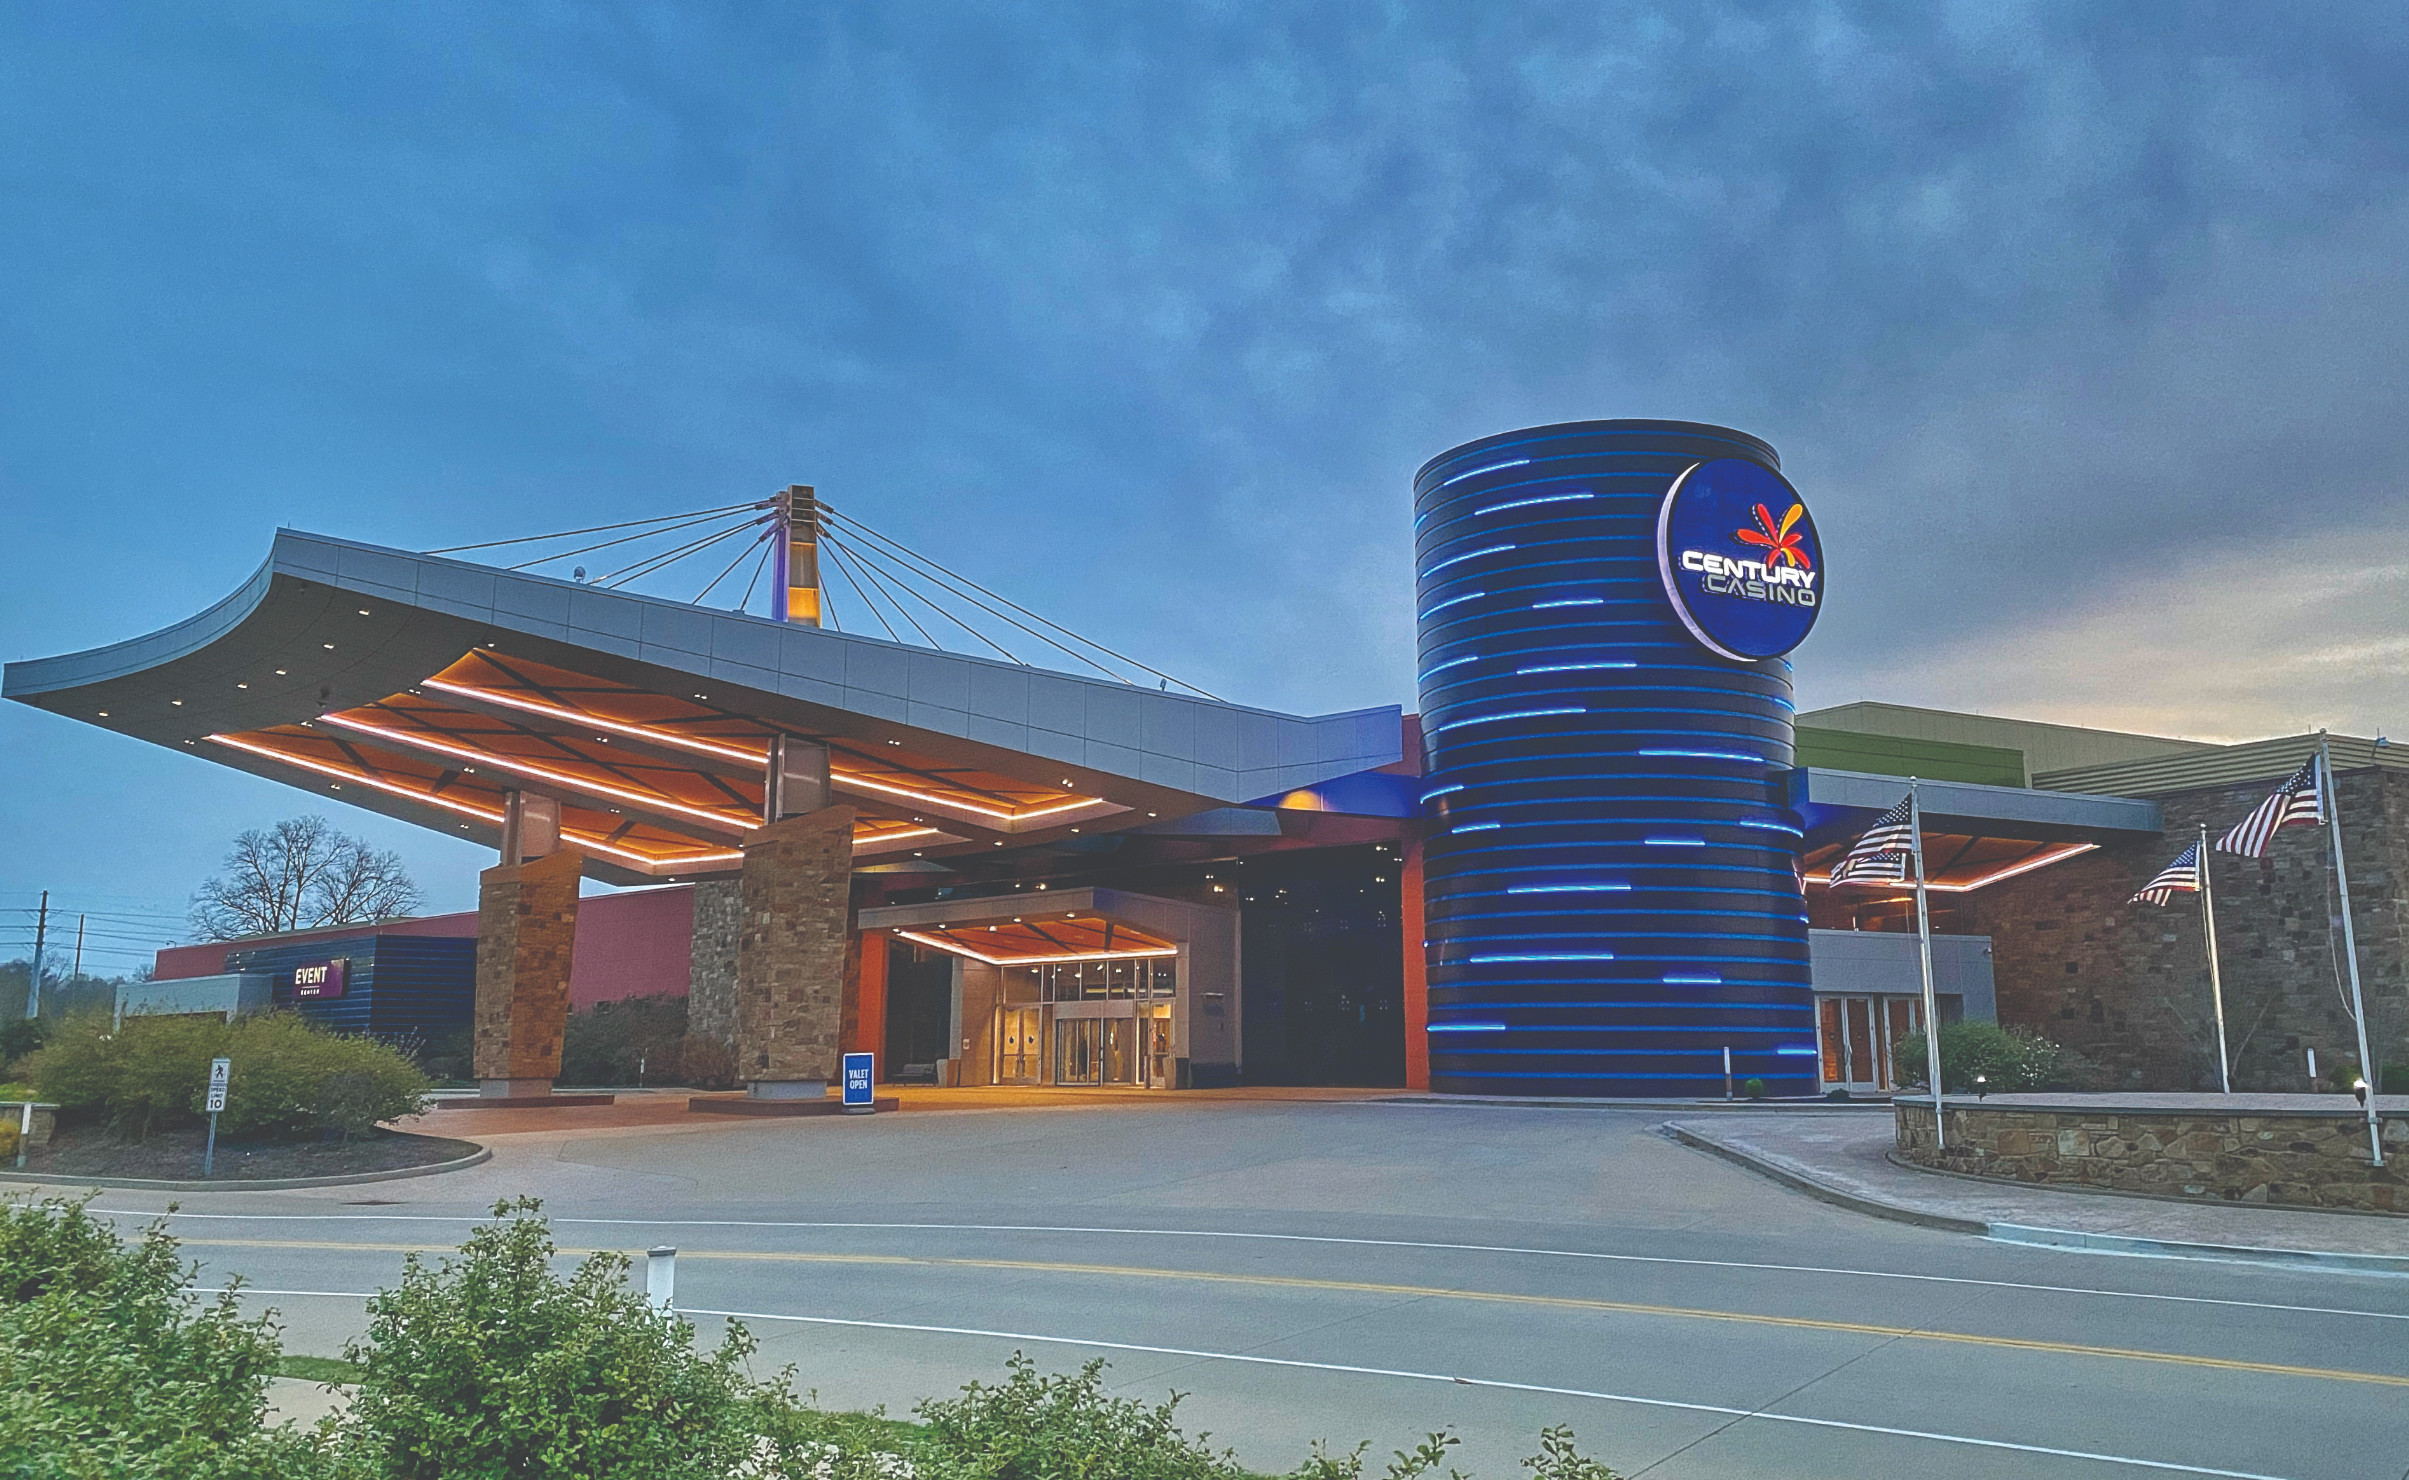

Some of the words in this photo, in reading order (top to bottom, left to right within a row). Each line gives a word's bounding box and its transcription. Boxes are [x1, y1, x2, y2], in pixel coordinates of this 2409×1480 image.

[1681, 550, 1816, 589] CENTURY
[1706, 573, 1816, 607] CASINO
[295, 966, 328, 985] EVENT
[849, 1069, 869, 1079] VALET
[849, 1079, 868, 1089] OPEN
[210, 1099, 222, 1109] 10
